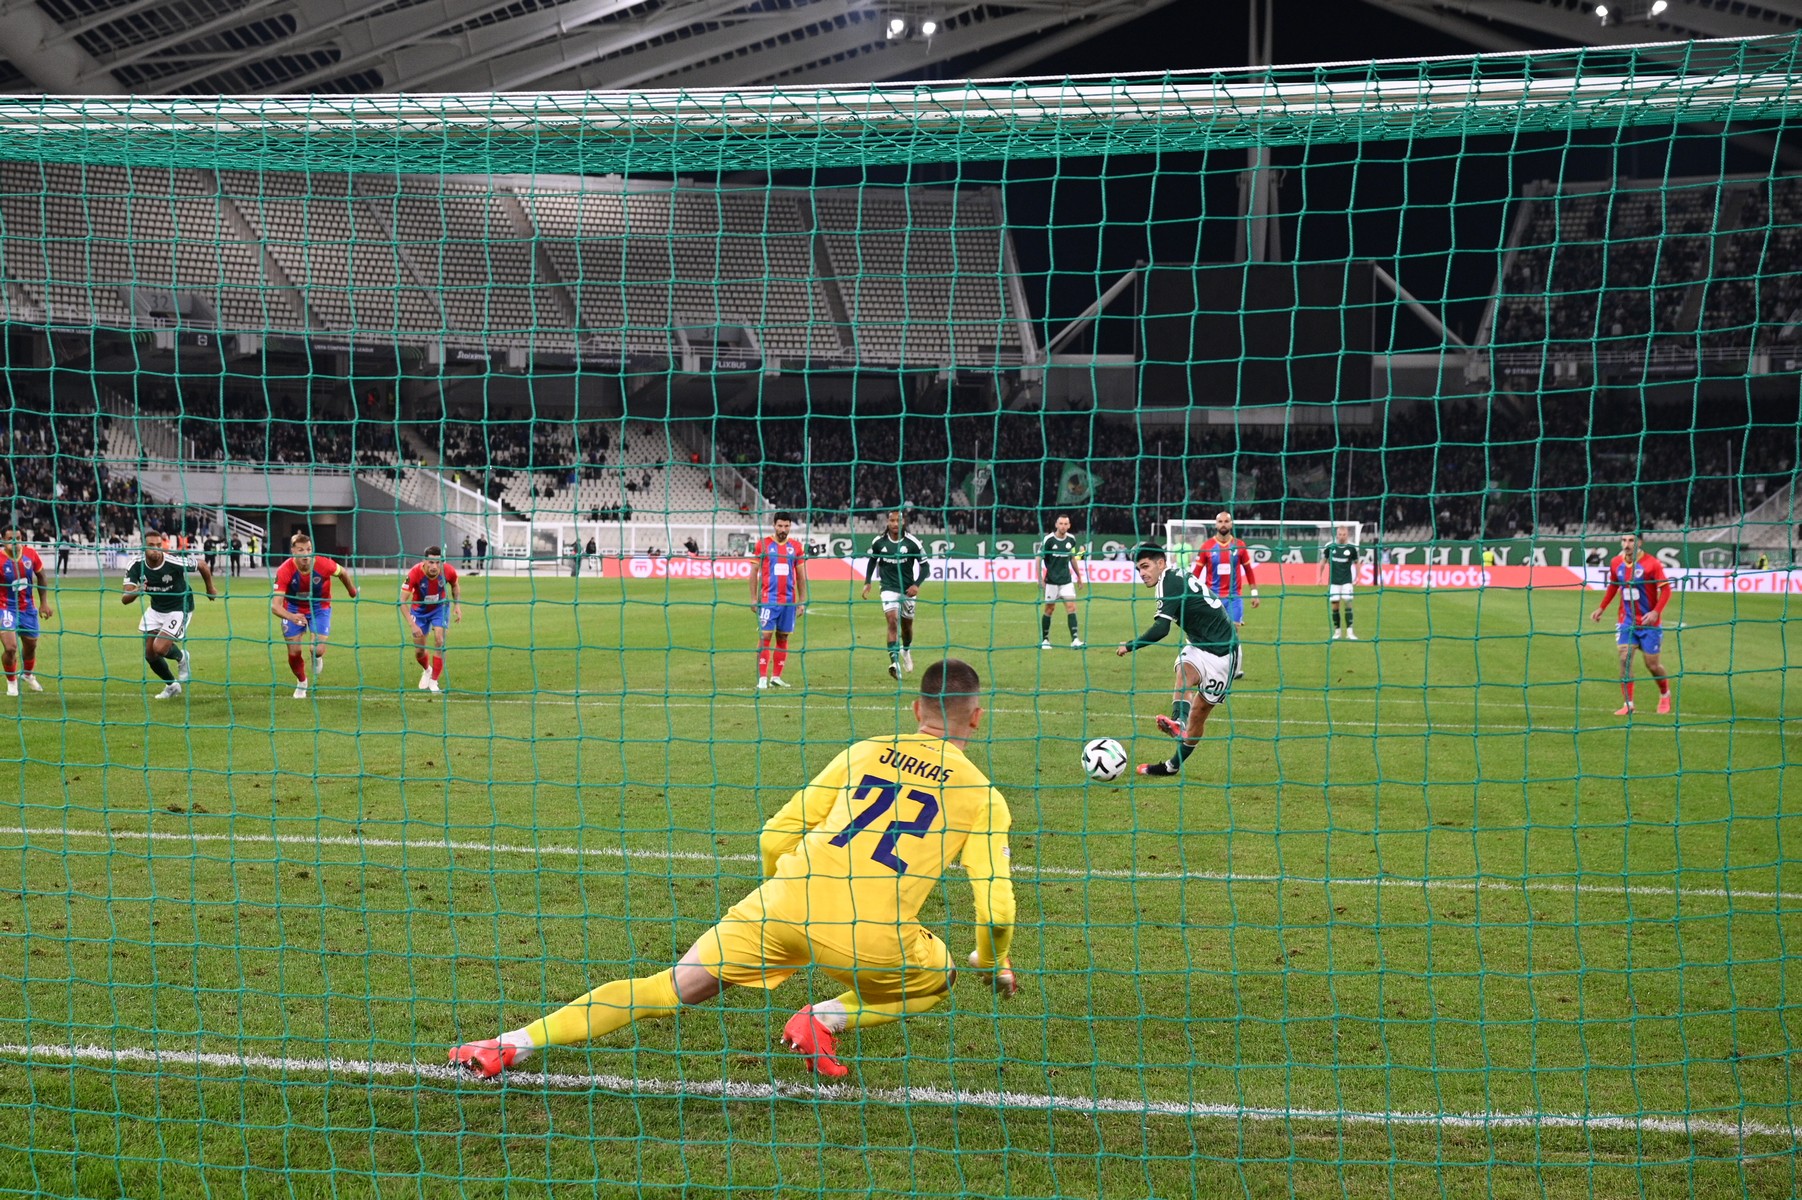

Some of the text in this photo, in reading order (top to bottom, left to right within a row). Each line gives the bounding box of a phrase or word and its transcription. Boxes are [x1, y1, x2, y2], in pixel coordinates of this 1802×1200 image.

[150, 294, 170, 310] 32
[984, 562, 1020, 580] For
[1360, 564, 1491, 587] Swissquote
[1724, 571, 1765, 591] For
[760, 607, 770, 620] 18
[168, 619, 178, 630] 9
[1205, 678, 1225, 696] 20
[879, 747, 954, 784] JURKAS
[827, 773, 940, 875] 72
